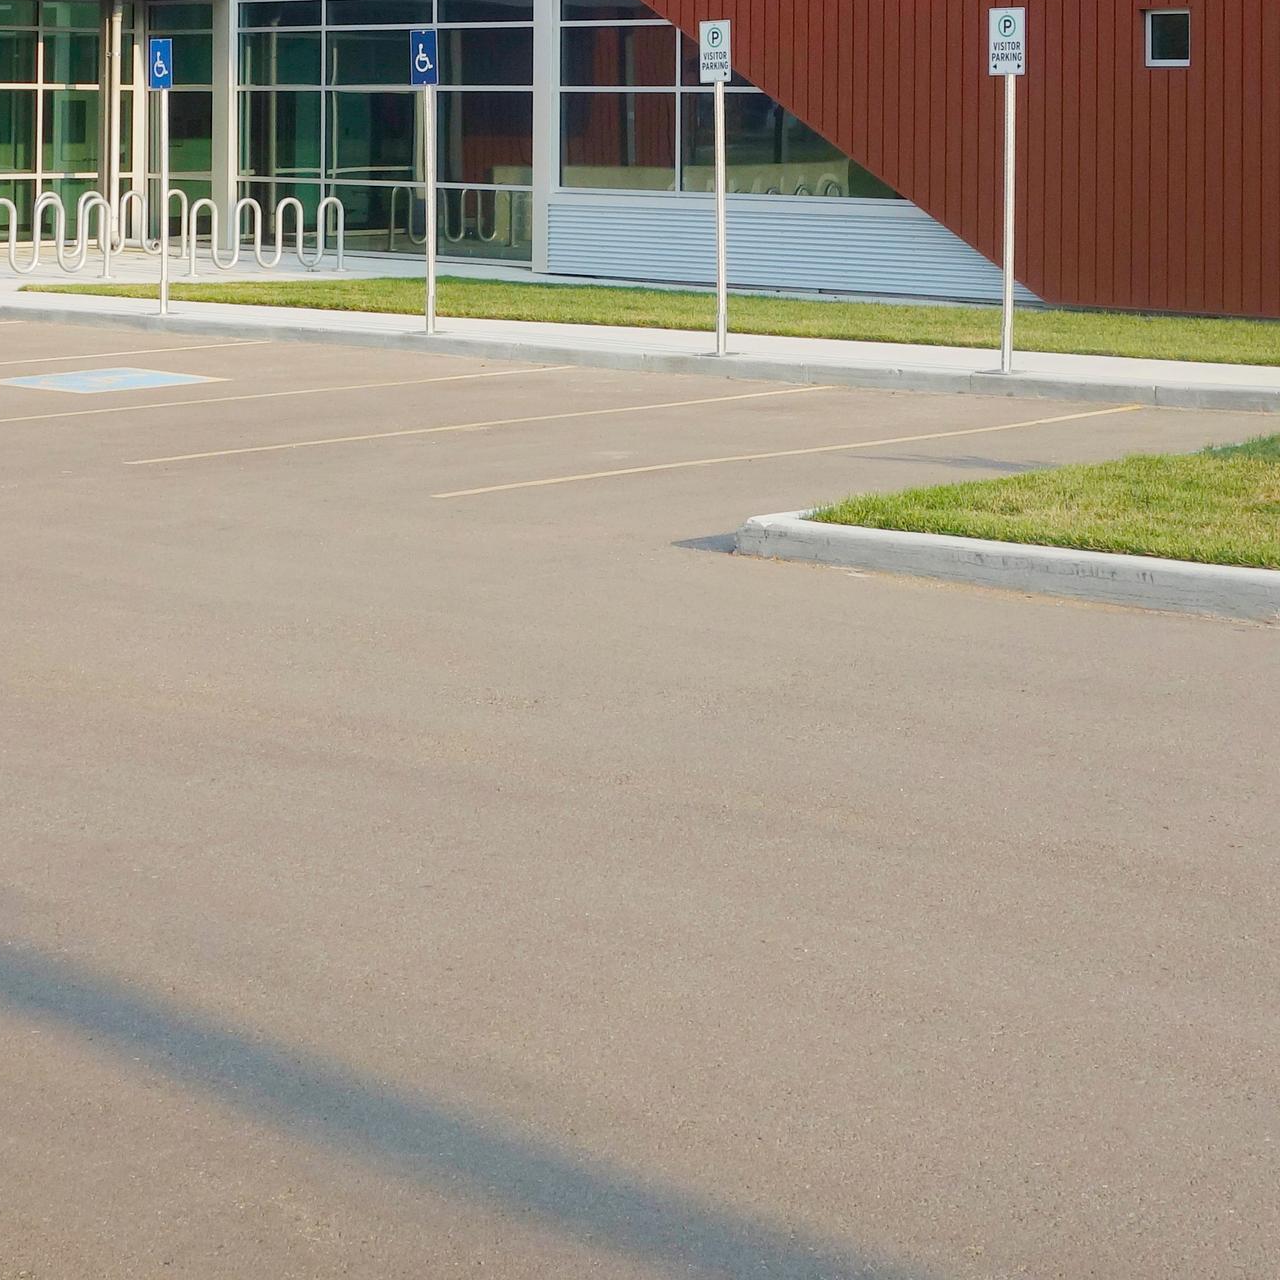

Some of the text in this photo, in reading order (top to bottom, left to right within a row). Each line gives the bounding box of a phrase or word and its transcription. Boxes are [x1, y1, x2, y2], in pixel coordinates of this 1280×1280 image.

[1004, 19, 1012, 33] P
[711, 31, 719, 44] P
[993, 41, 1020, 51] VISITOR
[703, 51, 727, 61] VISITOR
[991, 52, 1022, 62] PARKING
[702, 61, 729, 70] PARKING
